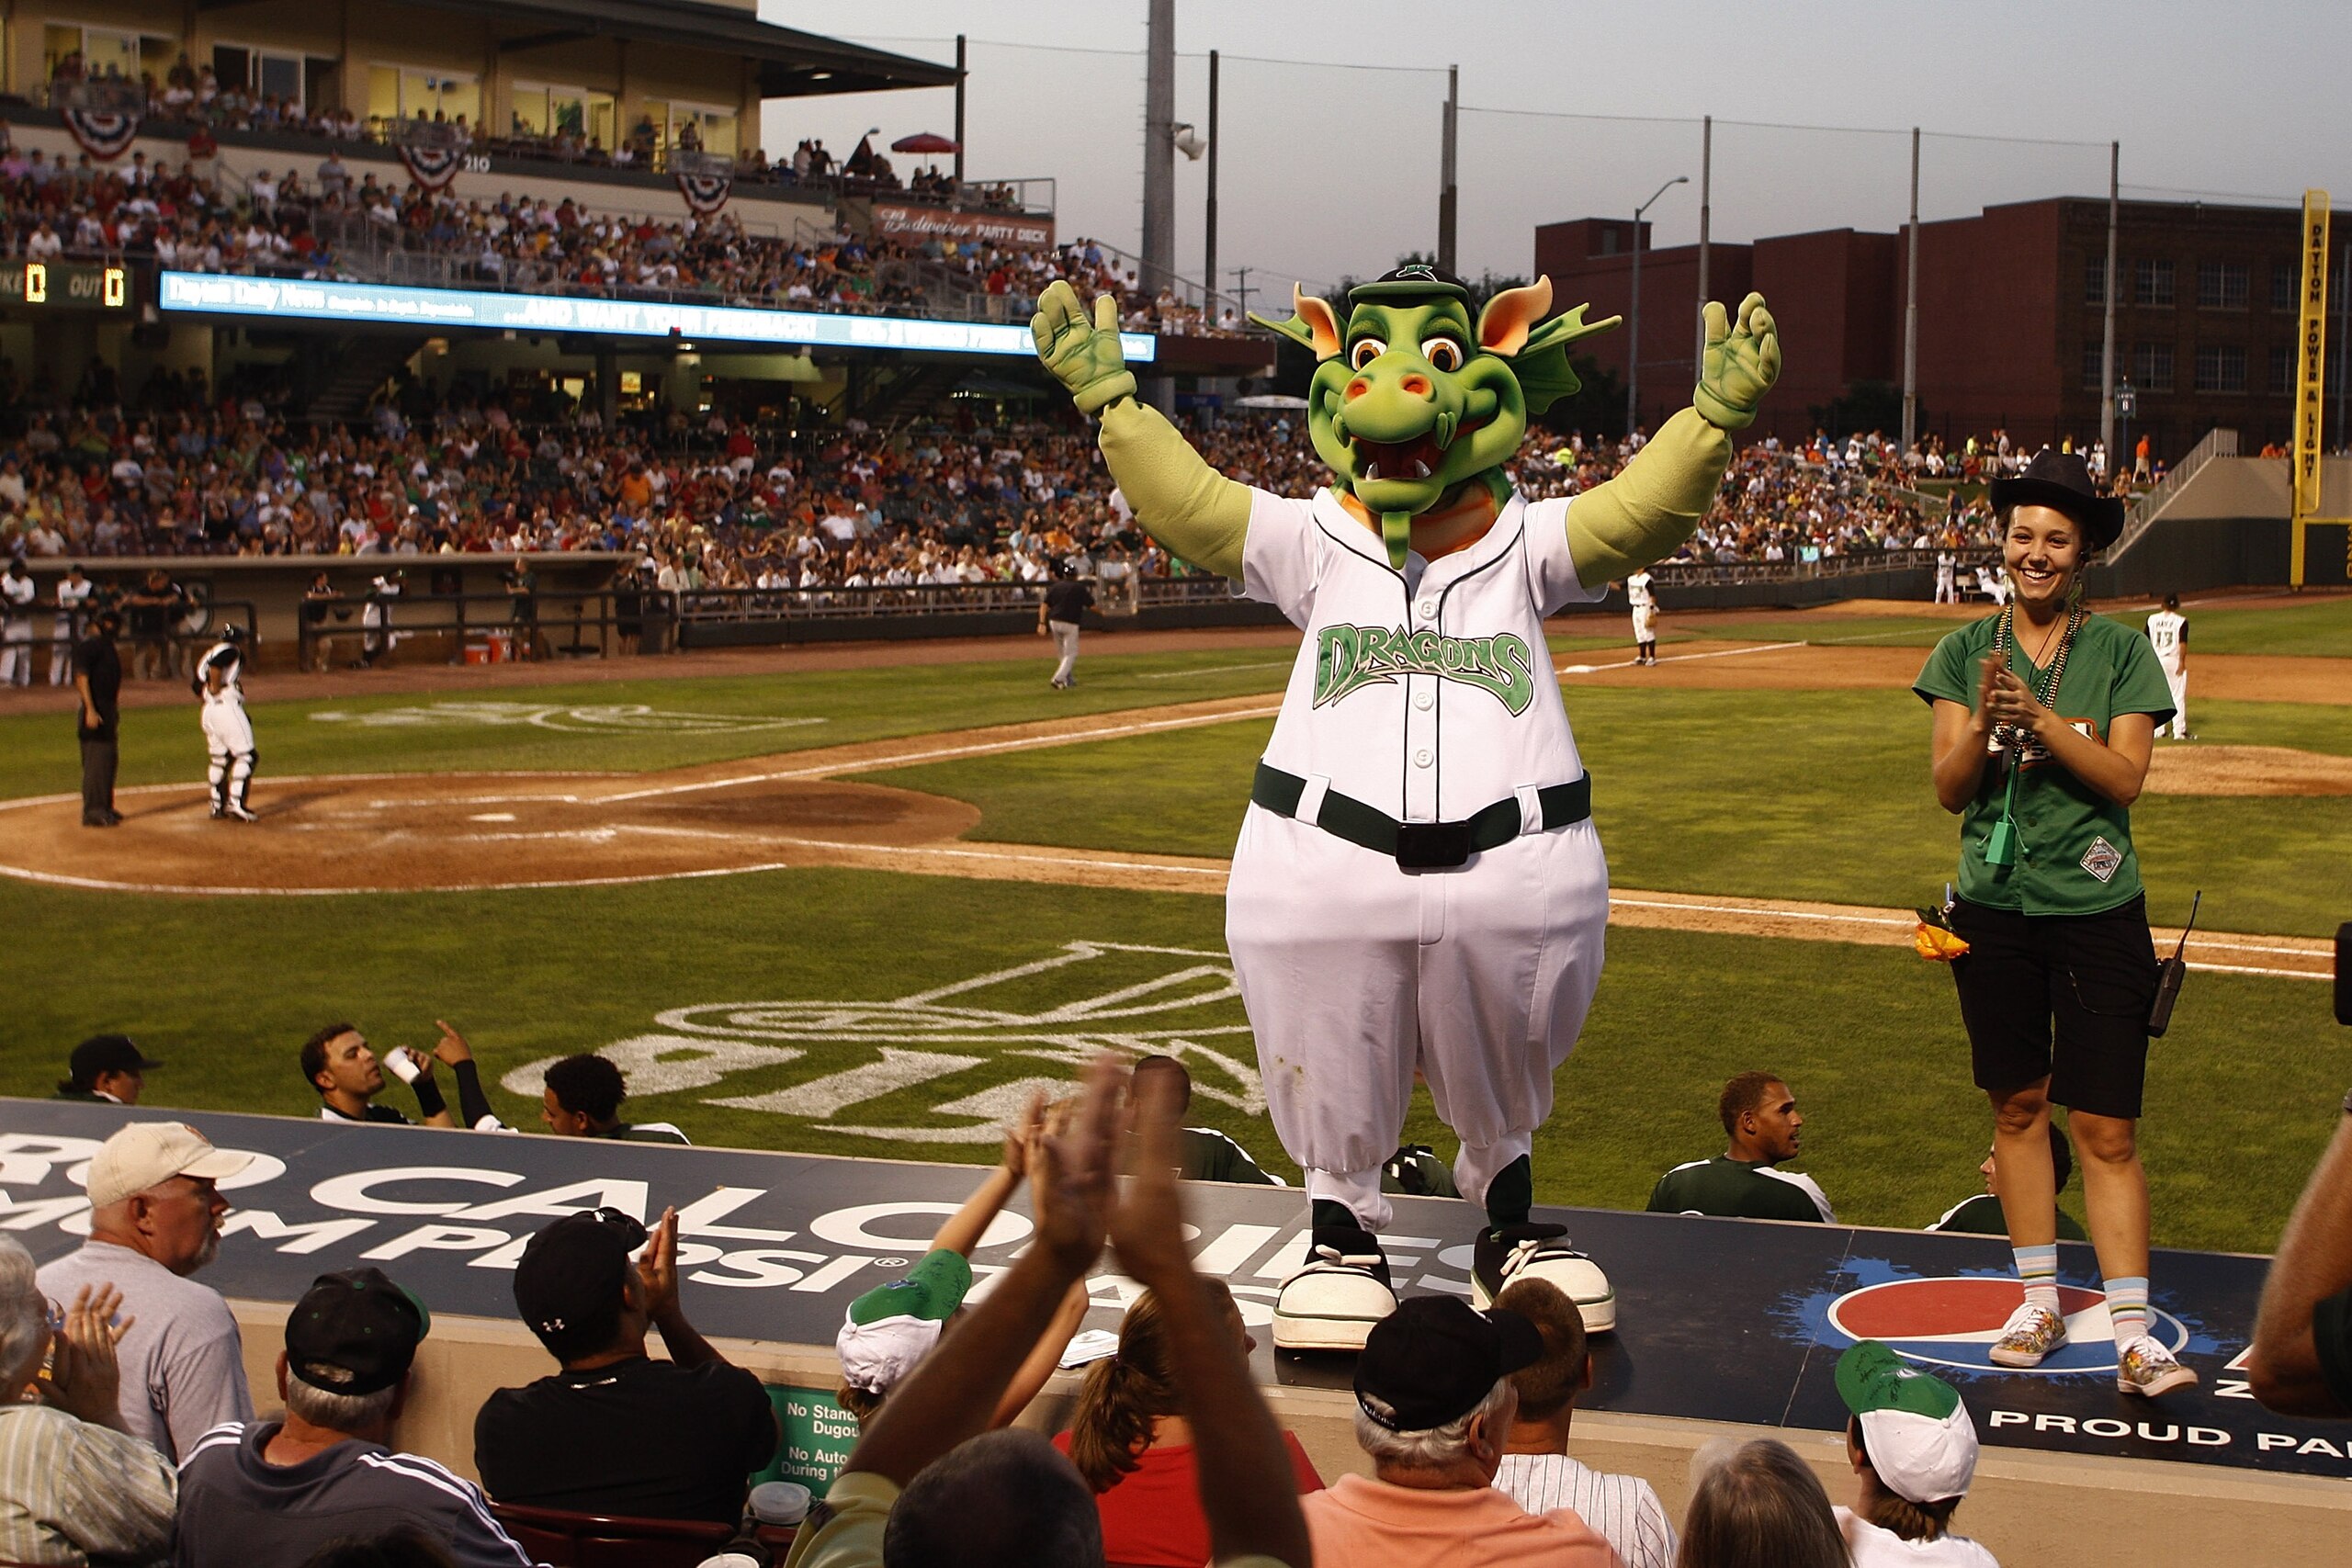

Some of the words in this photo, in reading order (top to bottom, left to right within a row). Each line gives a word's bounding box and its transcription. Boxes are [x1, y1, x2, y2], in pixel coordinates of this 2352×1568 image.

[464, 154, 491, 173] 210
[881, 208, 970, 238] Budweiser
[976, 224, 1014, 241] PARTY
[1016, 229, 1047, 243] DECK
[2309, 224, 2322, 303] DAYTON
[69, 275, 103, 298] OUT
[105, 268, 125, 307] 0
[576, 301, 639, 328] WANT
[2307, 319, 2319, 382] POWER
[2304, 412, 2315, 479] LIGHT
[1313, 622, 1534, 718] DRAGONS
[787, 1402, 808, 1417] No
[813, 1404, 860, 1422] Stand
[813, 1420, 861, 1439] Dugou
[1989, 1410, 2232, 1446] PROUD
[2256, 1432, 2352, 1459] PA
[781, 1461, 828, 1482] During
[788, 1446, 809, 1461] No
[814, 1448, 849, 1465] Auto
